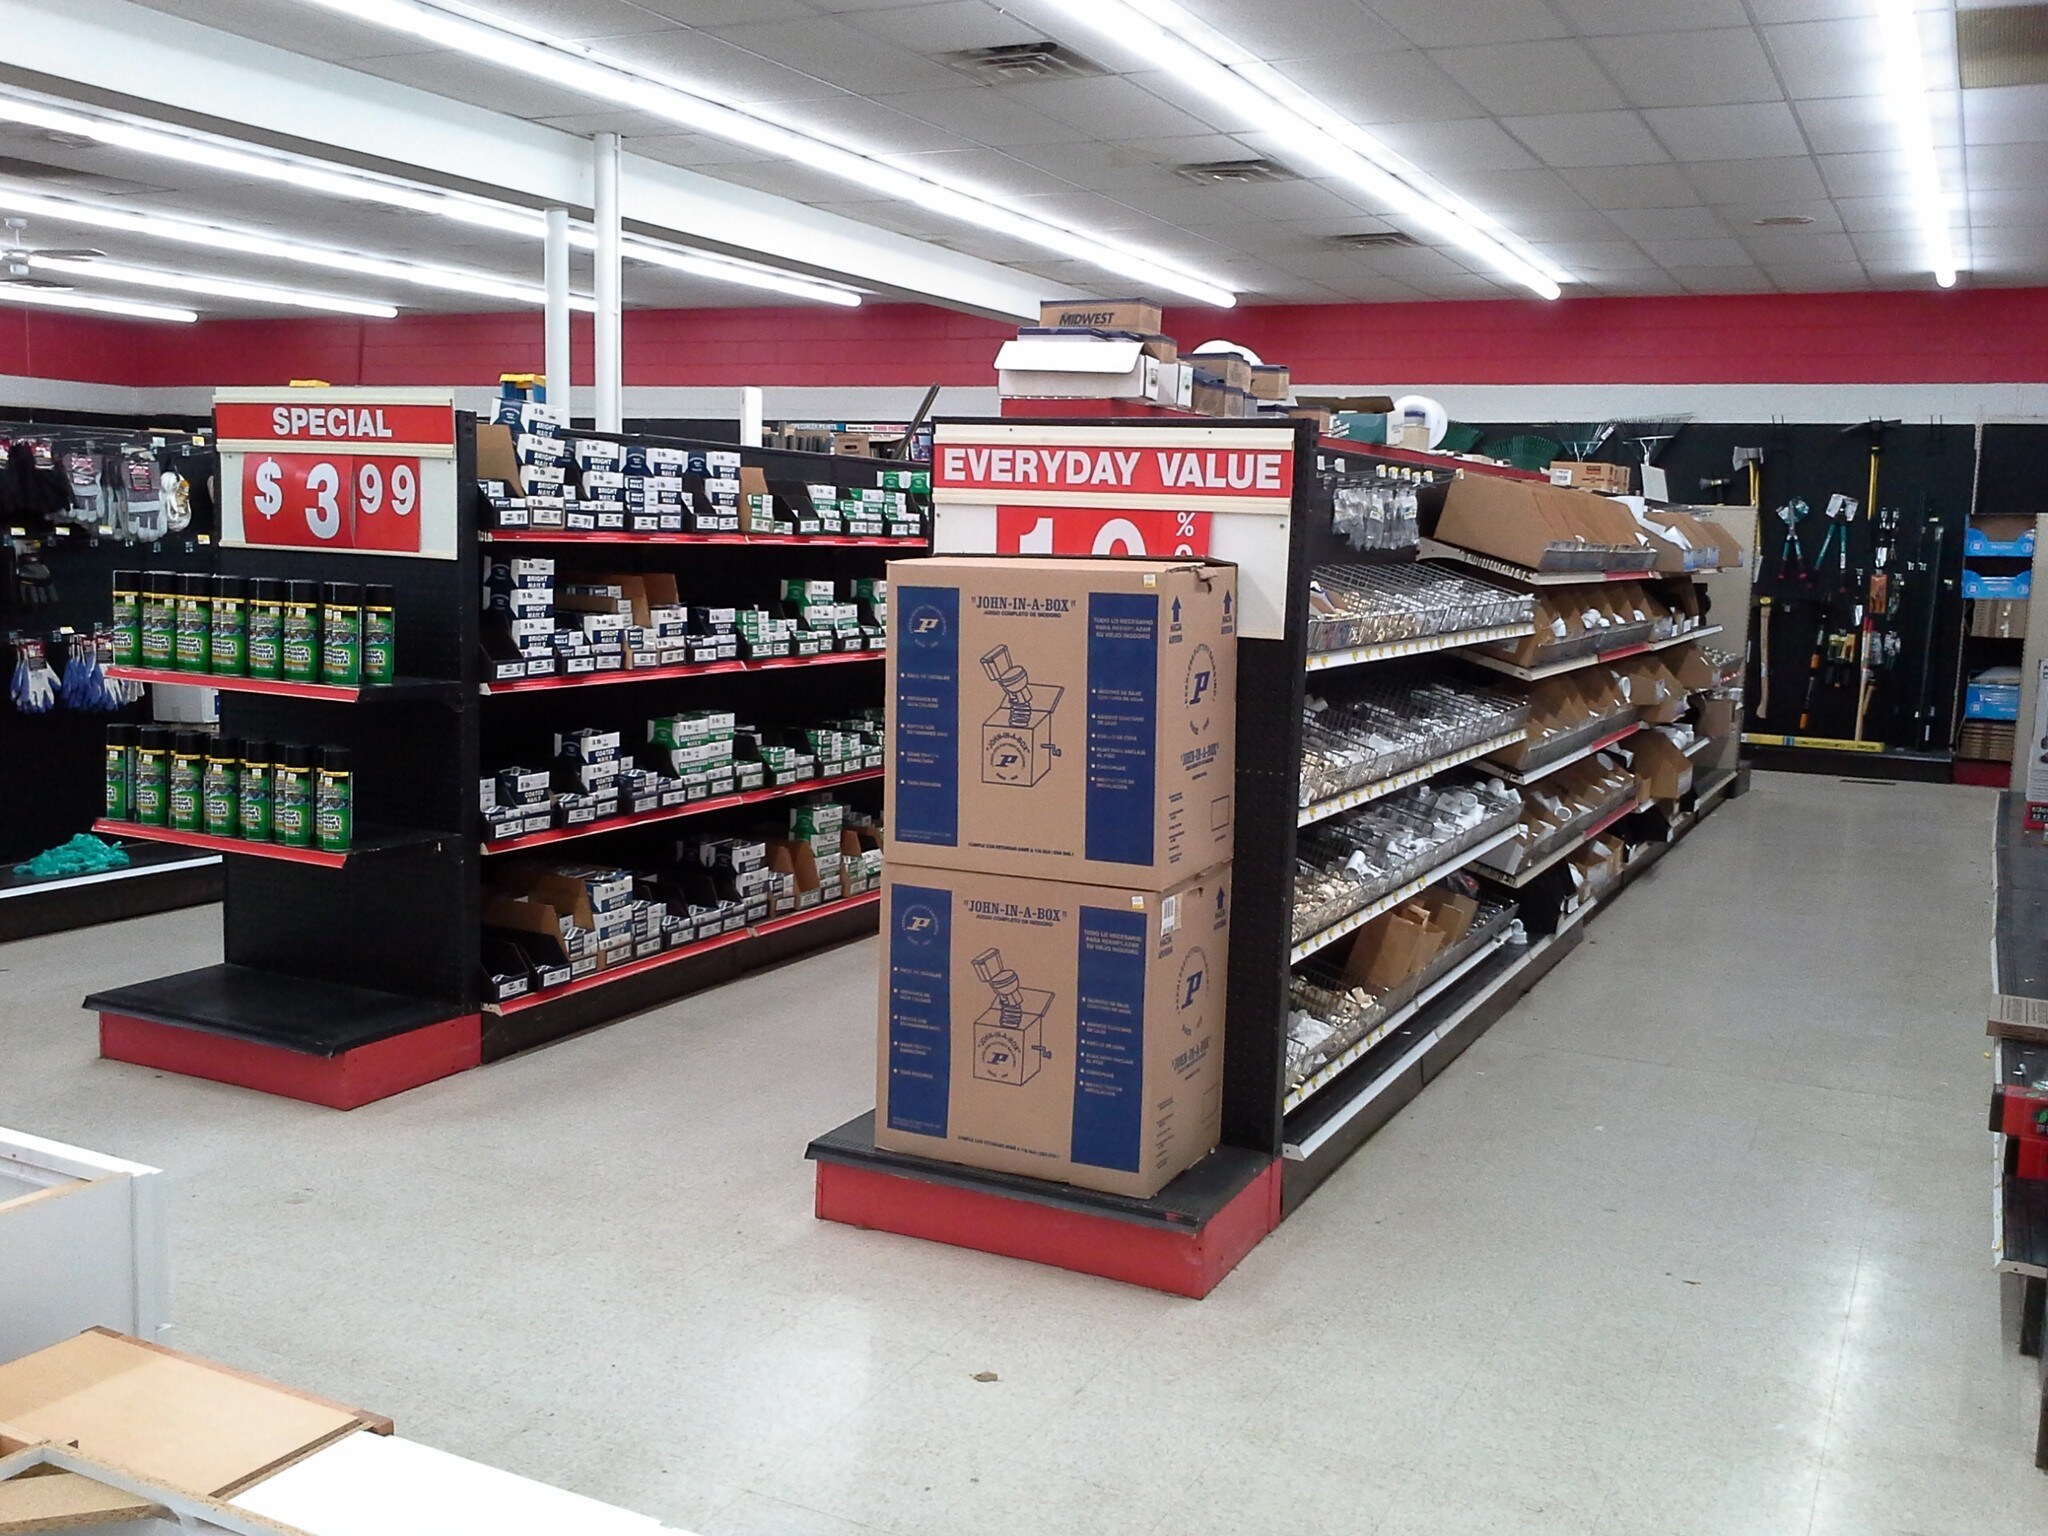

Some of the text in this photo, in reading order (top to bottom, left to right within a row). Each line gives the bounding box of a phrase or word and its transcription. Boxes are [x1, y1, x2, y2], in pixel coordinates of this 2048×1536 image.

[1059, 312, 1115, 326] MIDWEST
[272, 406, 393, 438] SPECIAL
[536, 421, 556, 432] BRIGHT
[533, 451, 557, 463] BRIGHT
[590, 458, 613, 466] BRIGHT
[943, 447, 1283, 490] EVERYDAY VALUE
[254, 456, 284, 520] $
[536, 482, 559, 491] BRIGHT
[597, 487, 618, 495] BRIGHT
[914, 618, 939, 633] P
[1119, 618, 1154, 626] NECESARIO
[528, 634, 549, 642] BRIGHT
[1188, 670, 1211, 705] P
[595, 748, 615, 758] COATED
[595, 776, 614, 786] COATED
[524, 790, 545, 799] COATED
[905, 915, 931, 931] P
[993, 916, 1021, 924] COMPLETO
[1109, 932, 1142, 942] NECESARIO
[1181, 970, 1203, 1010] P
